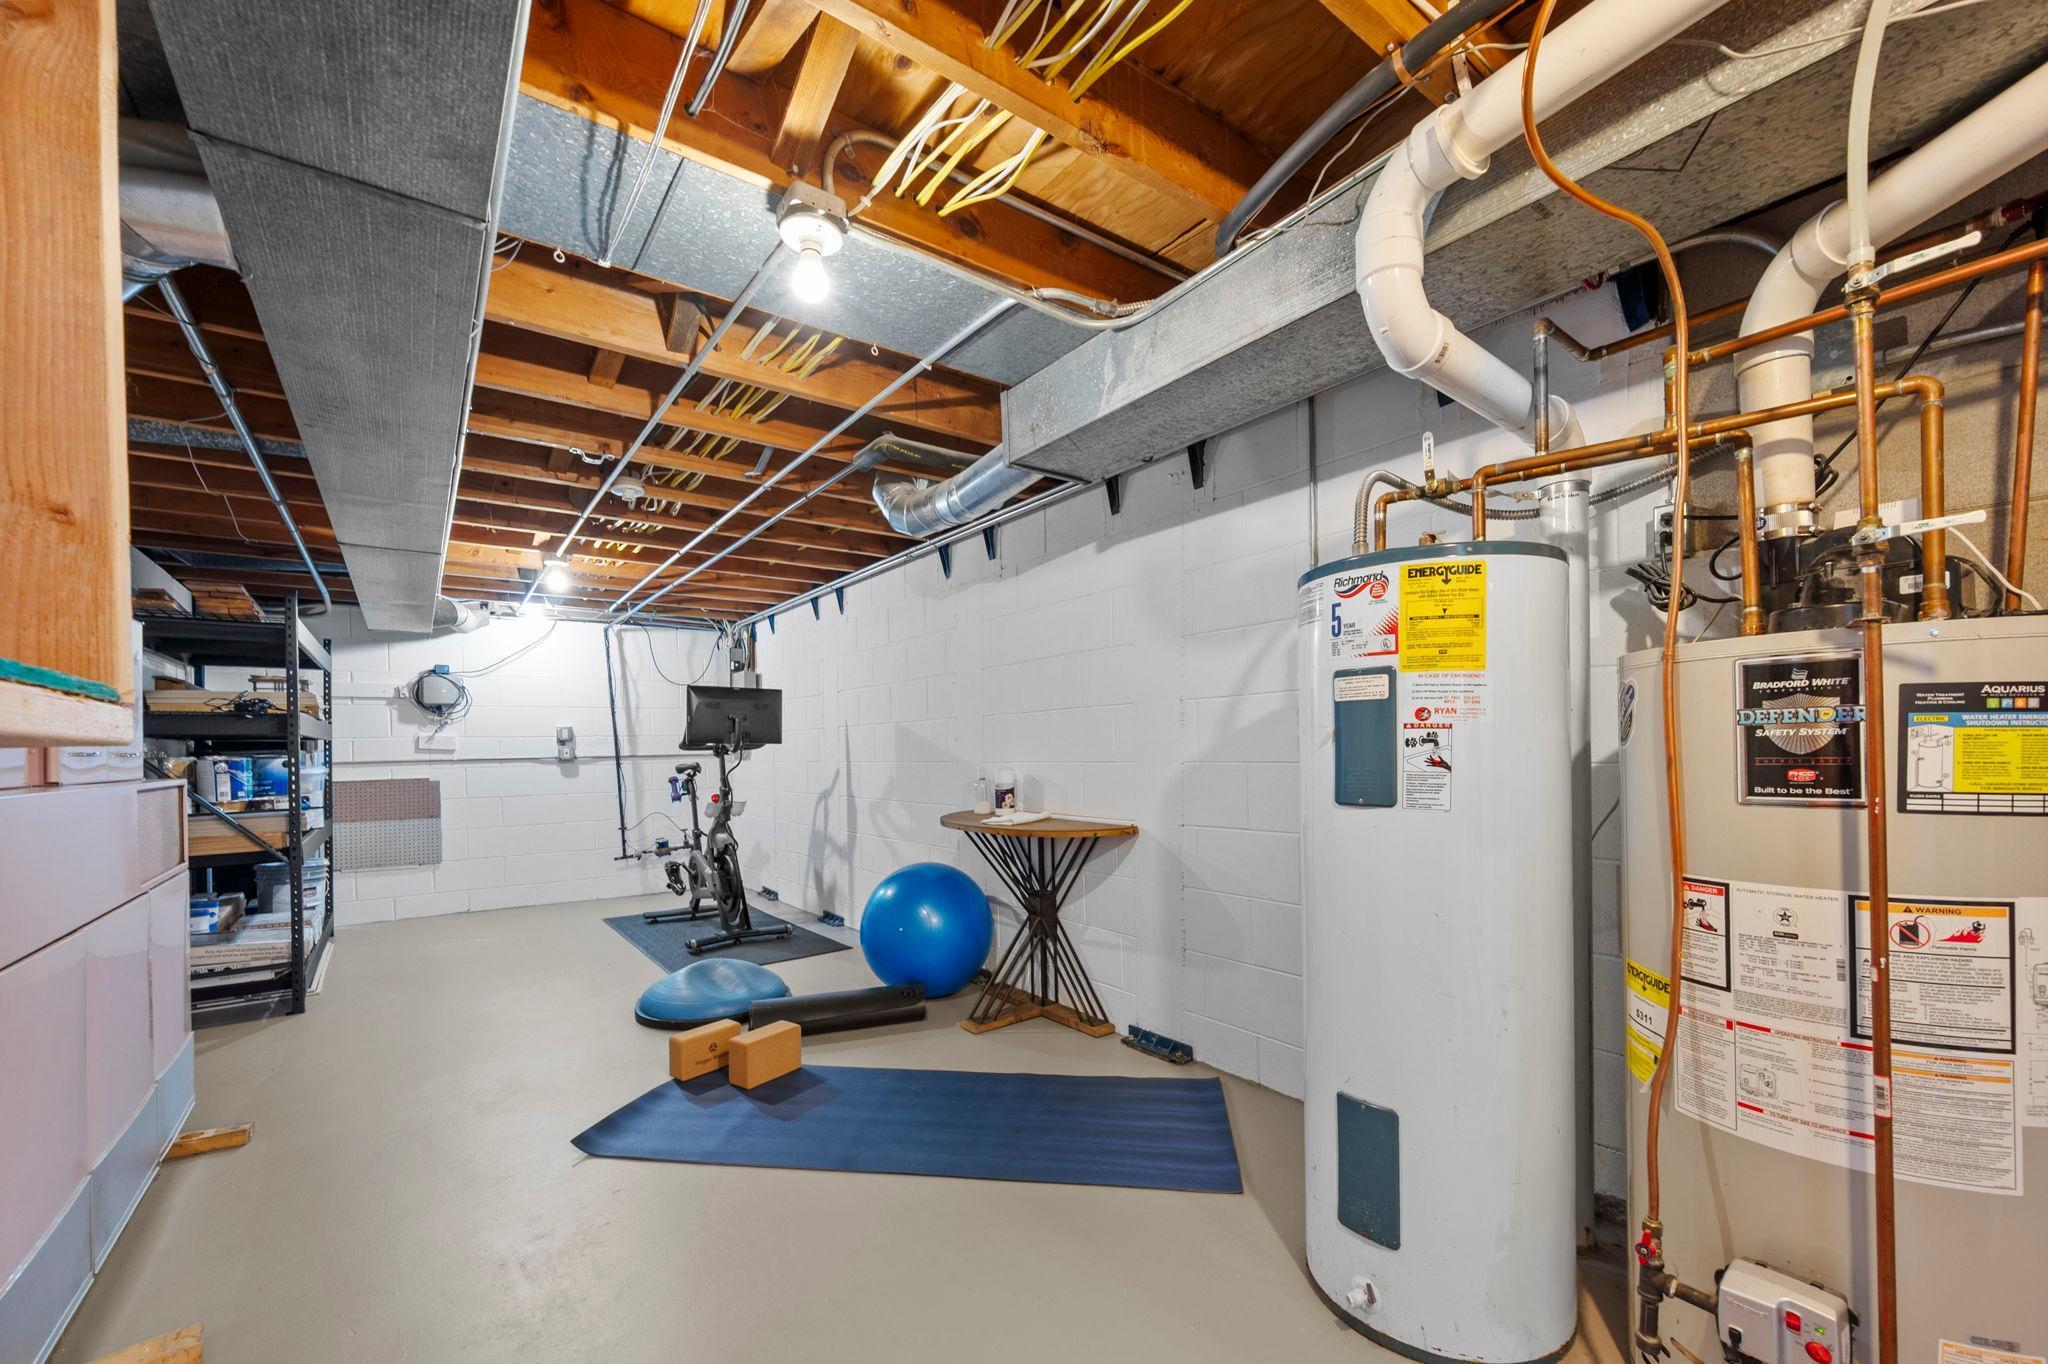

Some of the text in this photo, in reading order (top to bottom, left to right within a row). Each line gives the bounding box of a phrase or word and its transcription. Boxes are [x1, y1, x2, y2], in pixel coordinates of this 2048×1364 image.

[1408, 564, 1482, 579] ENERGYGUIDE
[1334, 571, 1383, 588] Richmond
[1332, 602, 1342, 638] 5
[1753, 678, 1849, 690] BRADFORD WHITE
[1981, 685, 2045, 693] AQUARIUS
[1738, 706, 1866, 725] DEFENDER
[1755, 728, 1846, 737] SAFETY SYSTEM
[1691, 885, 1718, 894] DANGER
[1775, 1030, 1838, 1045] OPERATING INSTRUCTIONS
[1819, 1124, 1847, 1134] APPLIANCE
